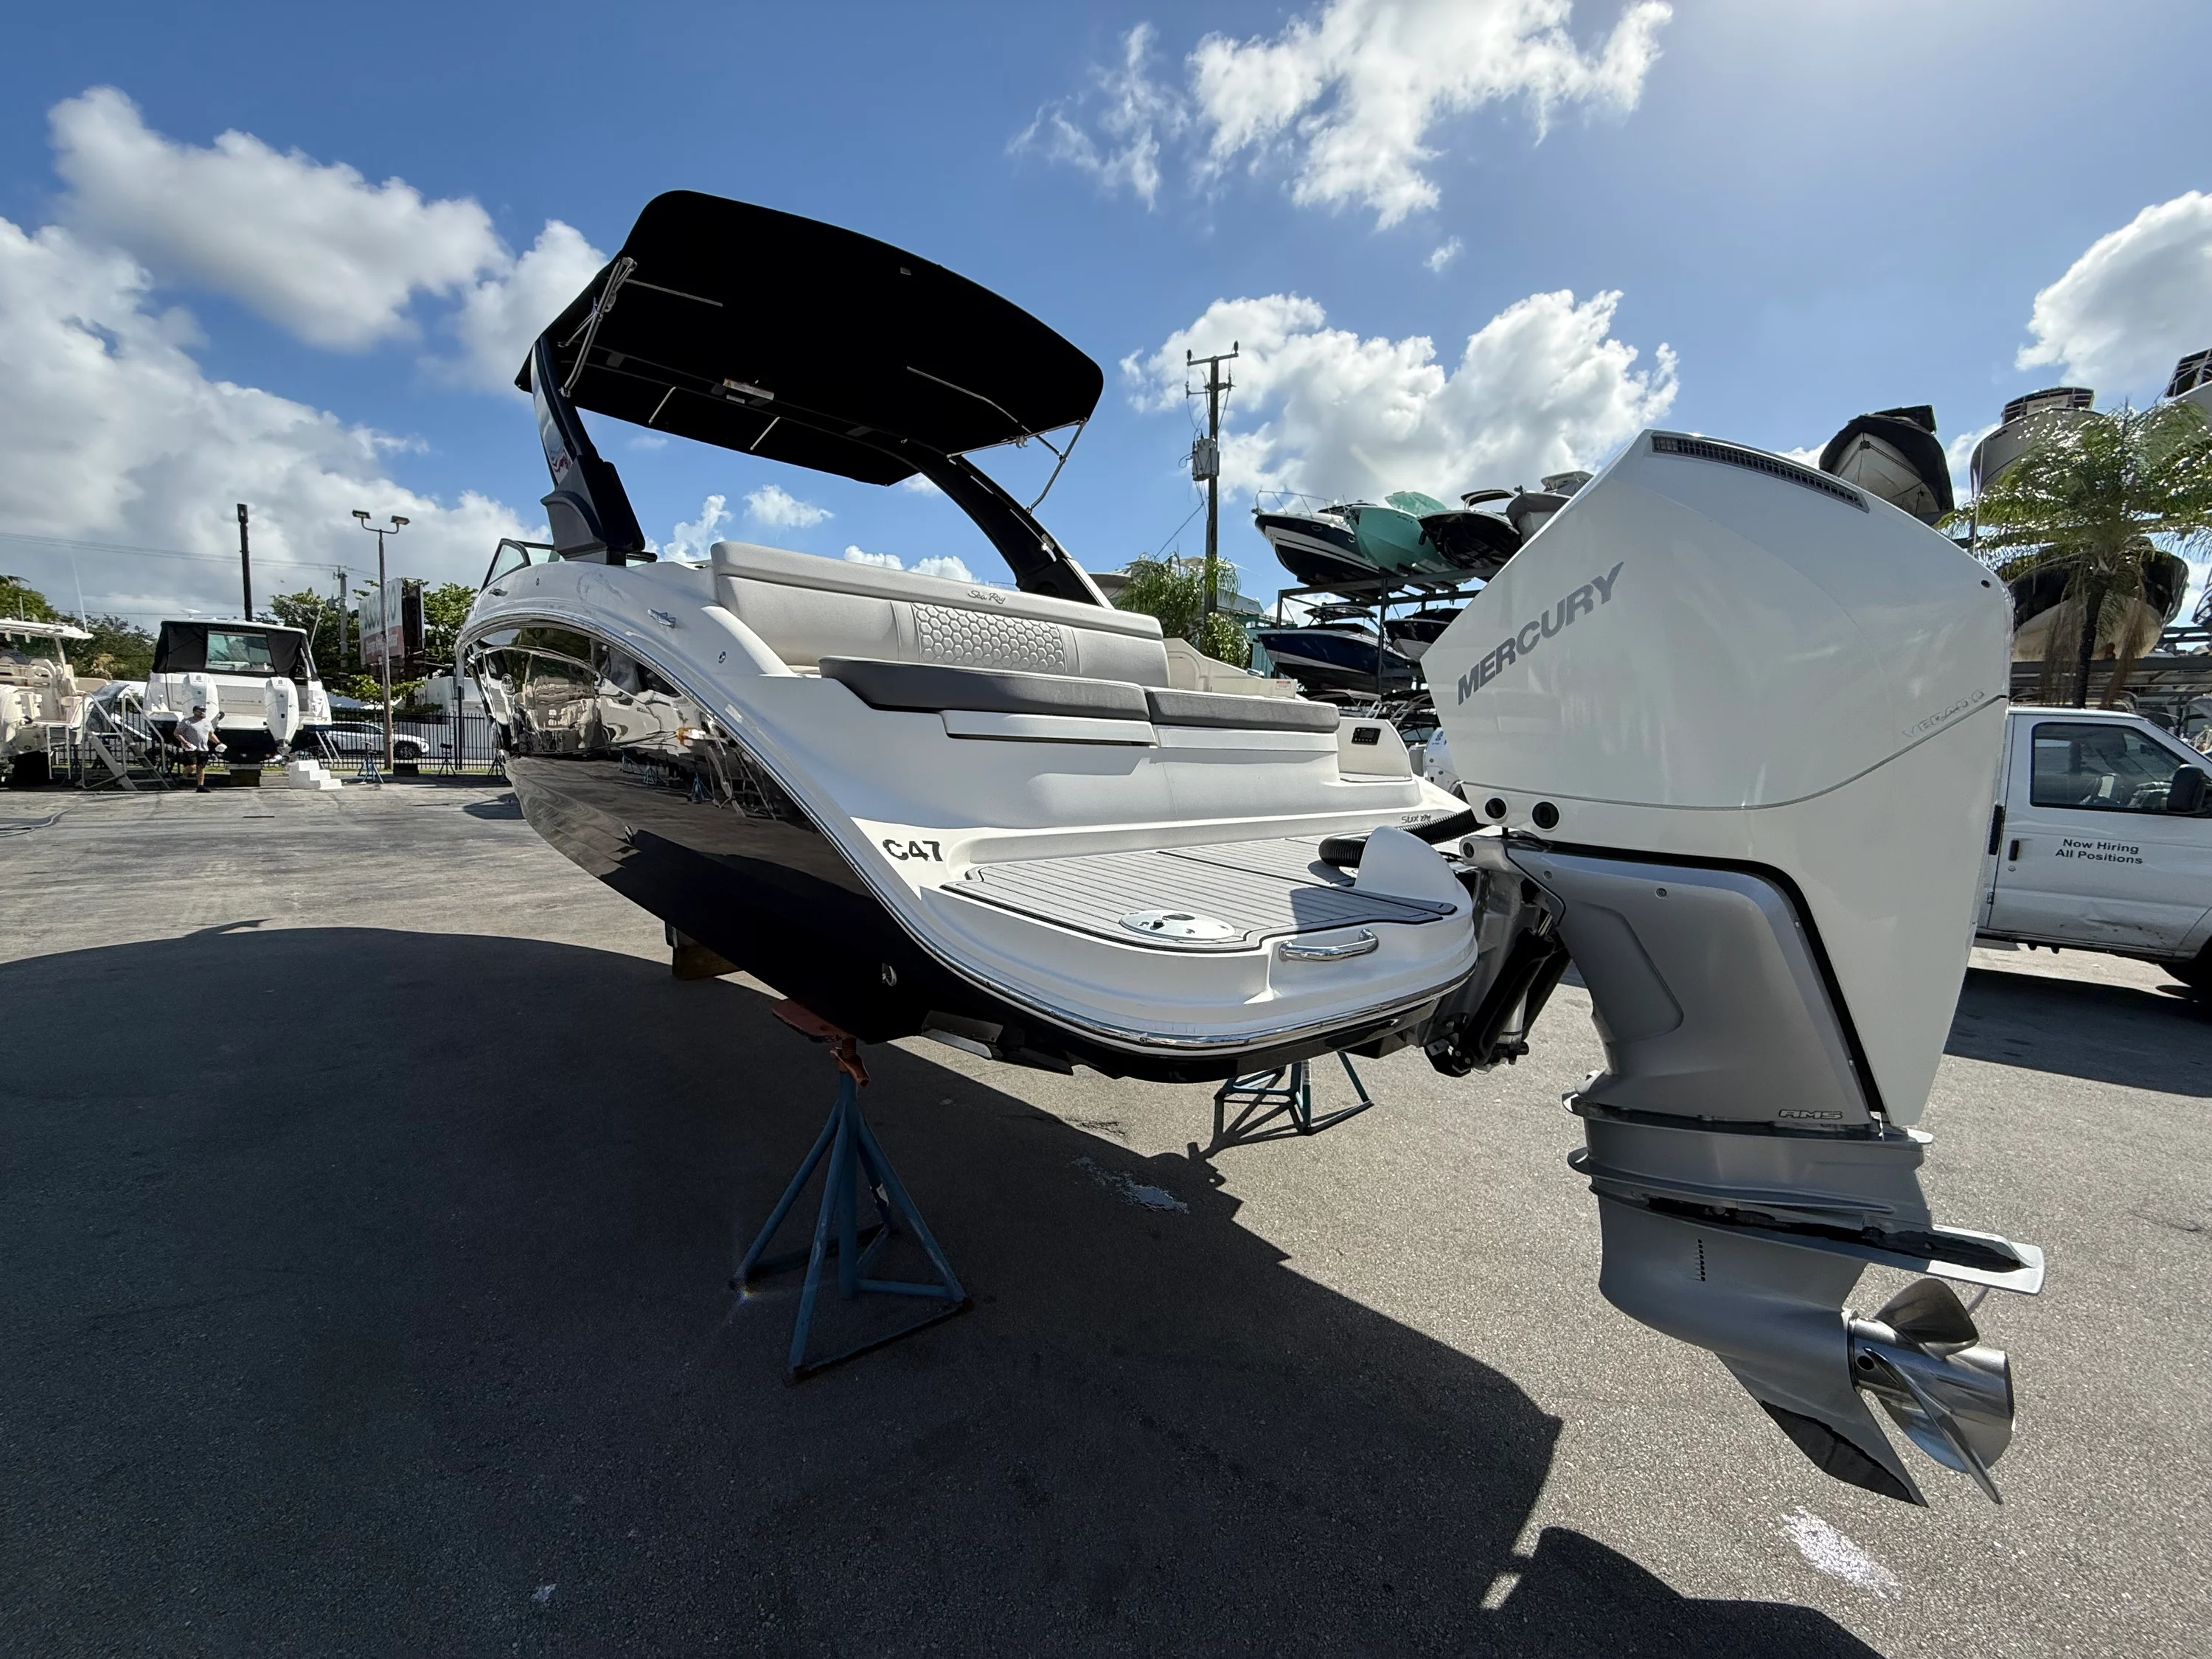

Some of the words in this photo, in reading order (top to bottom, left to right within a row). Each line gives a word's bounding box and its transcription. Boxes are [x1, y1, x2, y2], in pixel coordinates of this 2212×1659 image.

[967, 590, 987, 600] Sea
[989, 592, 1006, 605] Ray
[1458, 561, 1624, 706] MERCURY
[882, 839, 944, 861] C47
[2062, 838, 2093, 849] Now
[2096, 841, 2140, 855] Hiring
[2055, 849, 2073, 858] All
[2077, 850, 2143, 865] Positions
[1778, 1109, 1843, 1120] AMS
